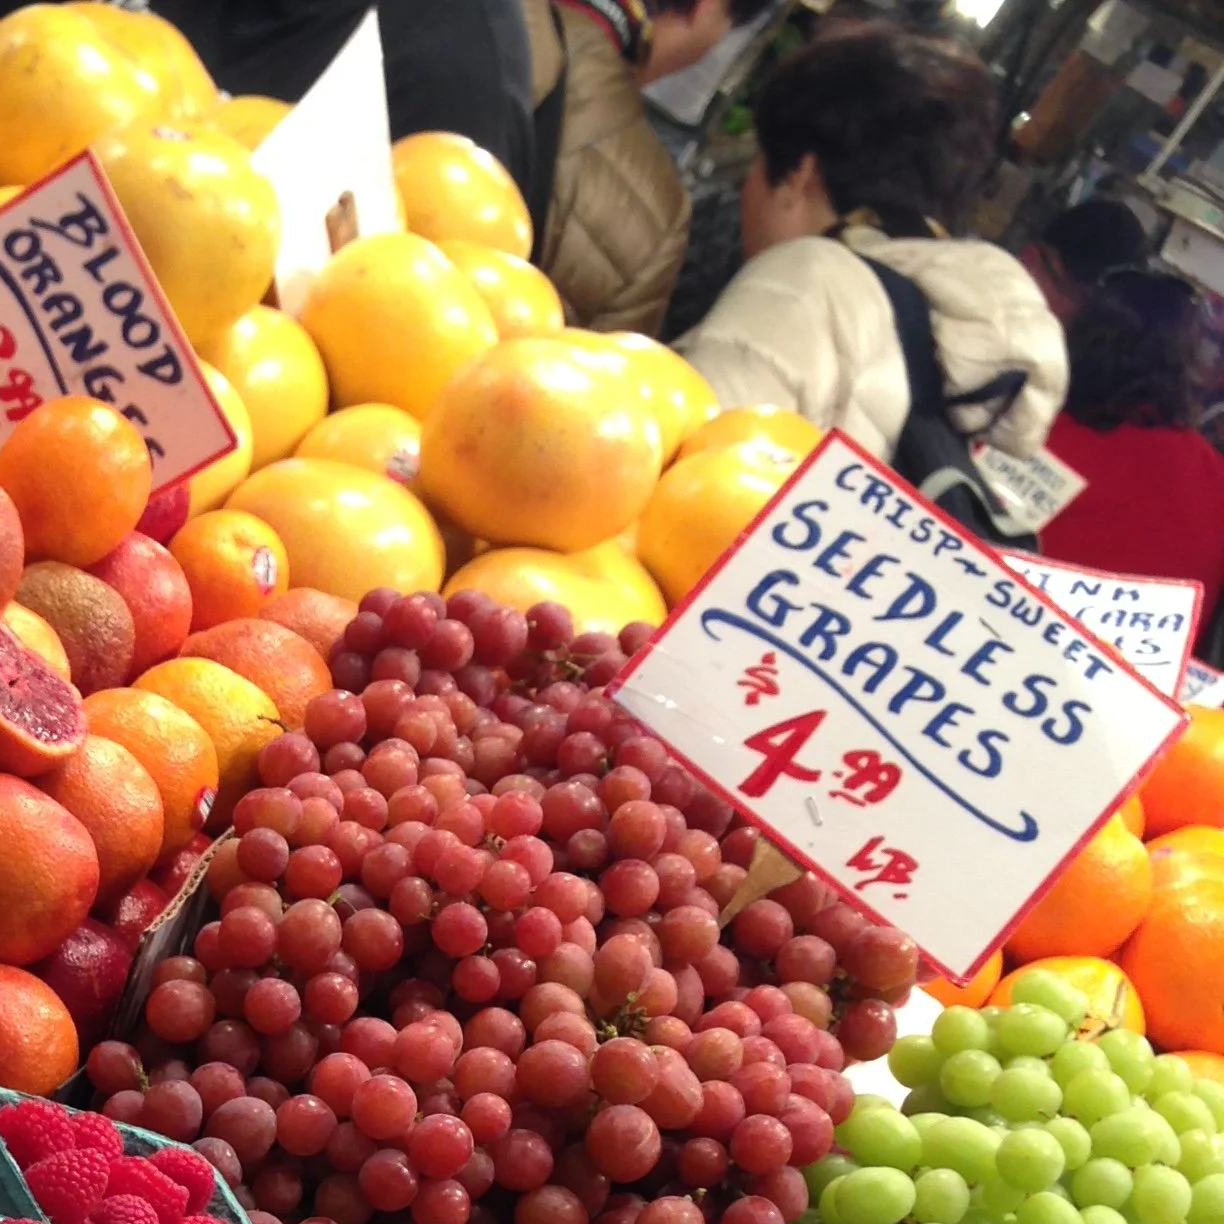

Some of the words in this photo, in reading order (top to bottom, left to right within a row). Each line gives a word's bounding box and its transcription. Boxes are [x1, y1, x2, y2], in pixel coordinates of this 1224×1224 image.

[30, 192, 183, 386] BLOOD
[746, 570, 1009, 778] GRAPES
[771, 501, 1092, 745] SEEDLESS
[834, 463, 964, 556] CRISP
[984, 580, 1114, 680] SWEET
